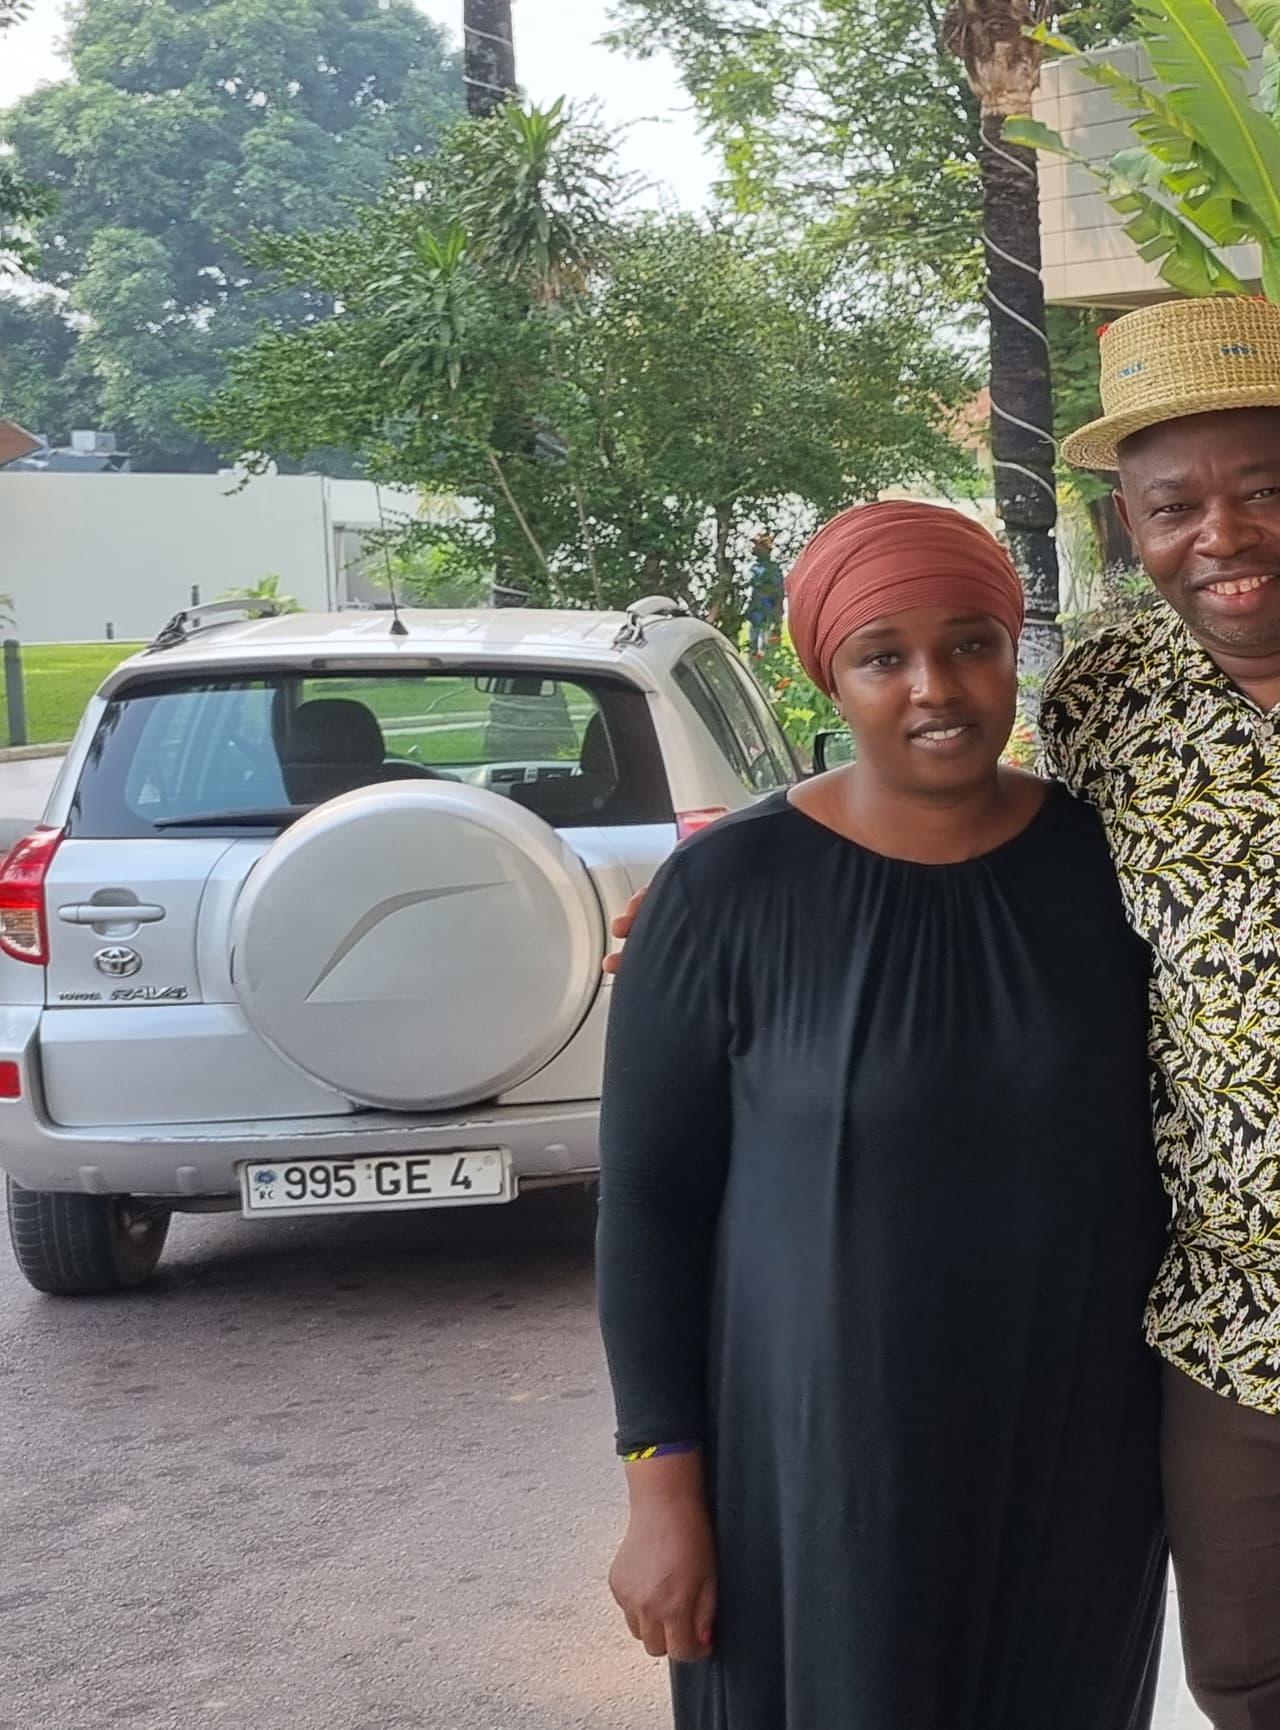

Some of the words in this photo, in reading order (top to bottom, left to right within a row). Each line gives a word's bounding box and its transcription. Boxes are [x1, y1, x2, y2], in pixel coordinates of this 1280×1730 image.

[110, 985, 188, 1001] RAV4
[284, 1164, 357, 1201] 995
[374, 1159, 432, 1196] GE
[450, 1157, 472, 1190] 4
